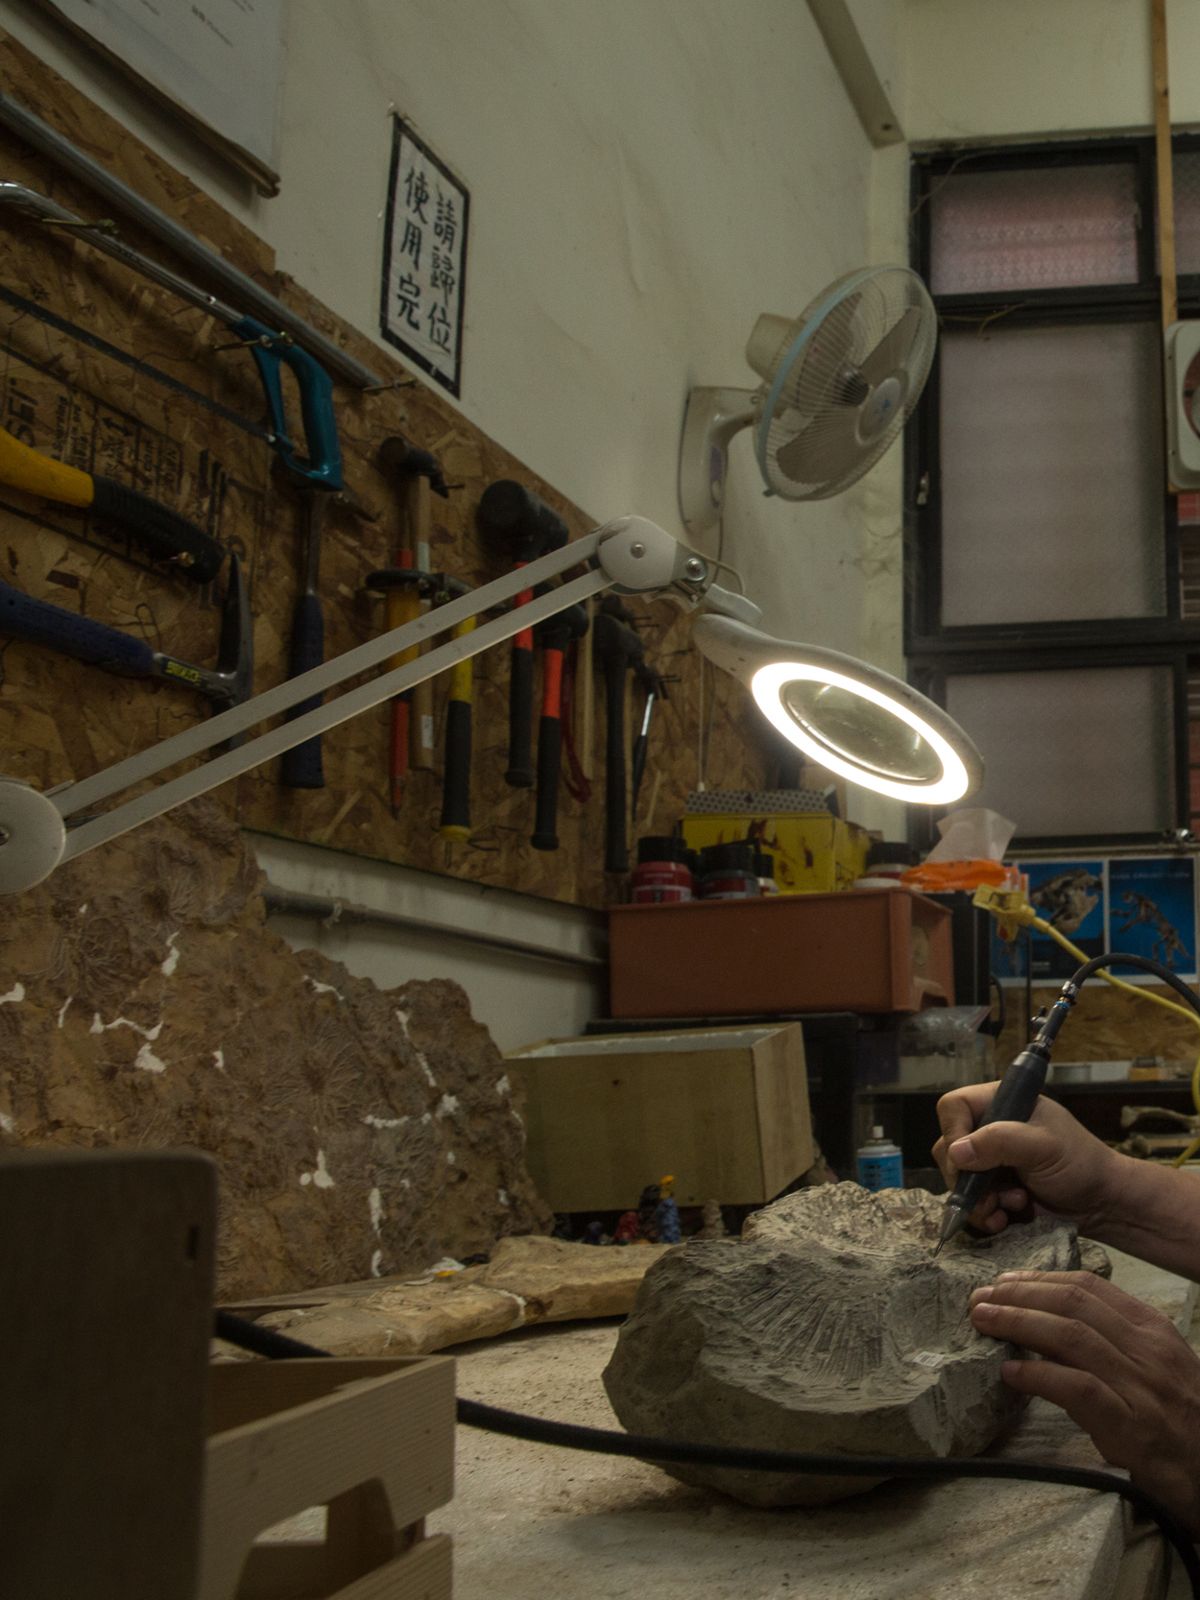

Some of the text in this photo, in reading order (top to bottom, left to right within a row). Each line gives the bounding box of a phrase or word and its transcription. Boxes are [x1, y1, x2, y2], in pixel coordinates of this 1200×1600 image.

[397, 166, 429, 331] 使用完
[427, 182, 457, 354] 請歸位
